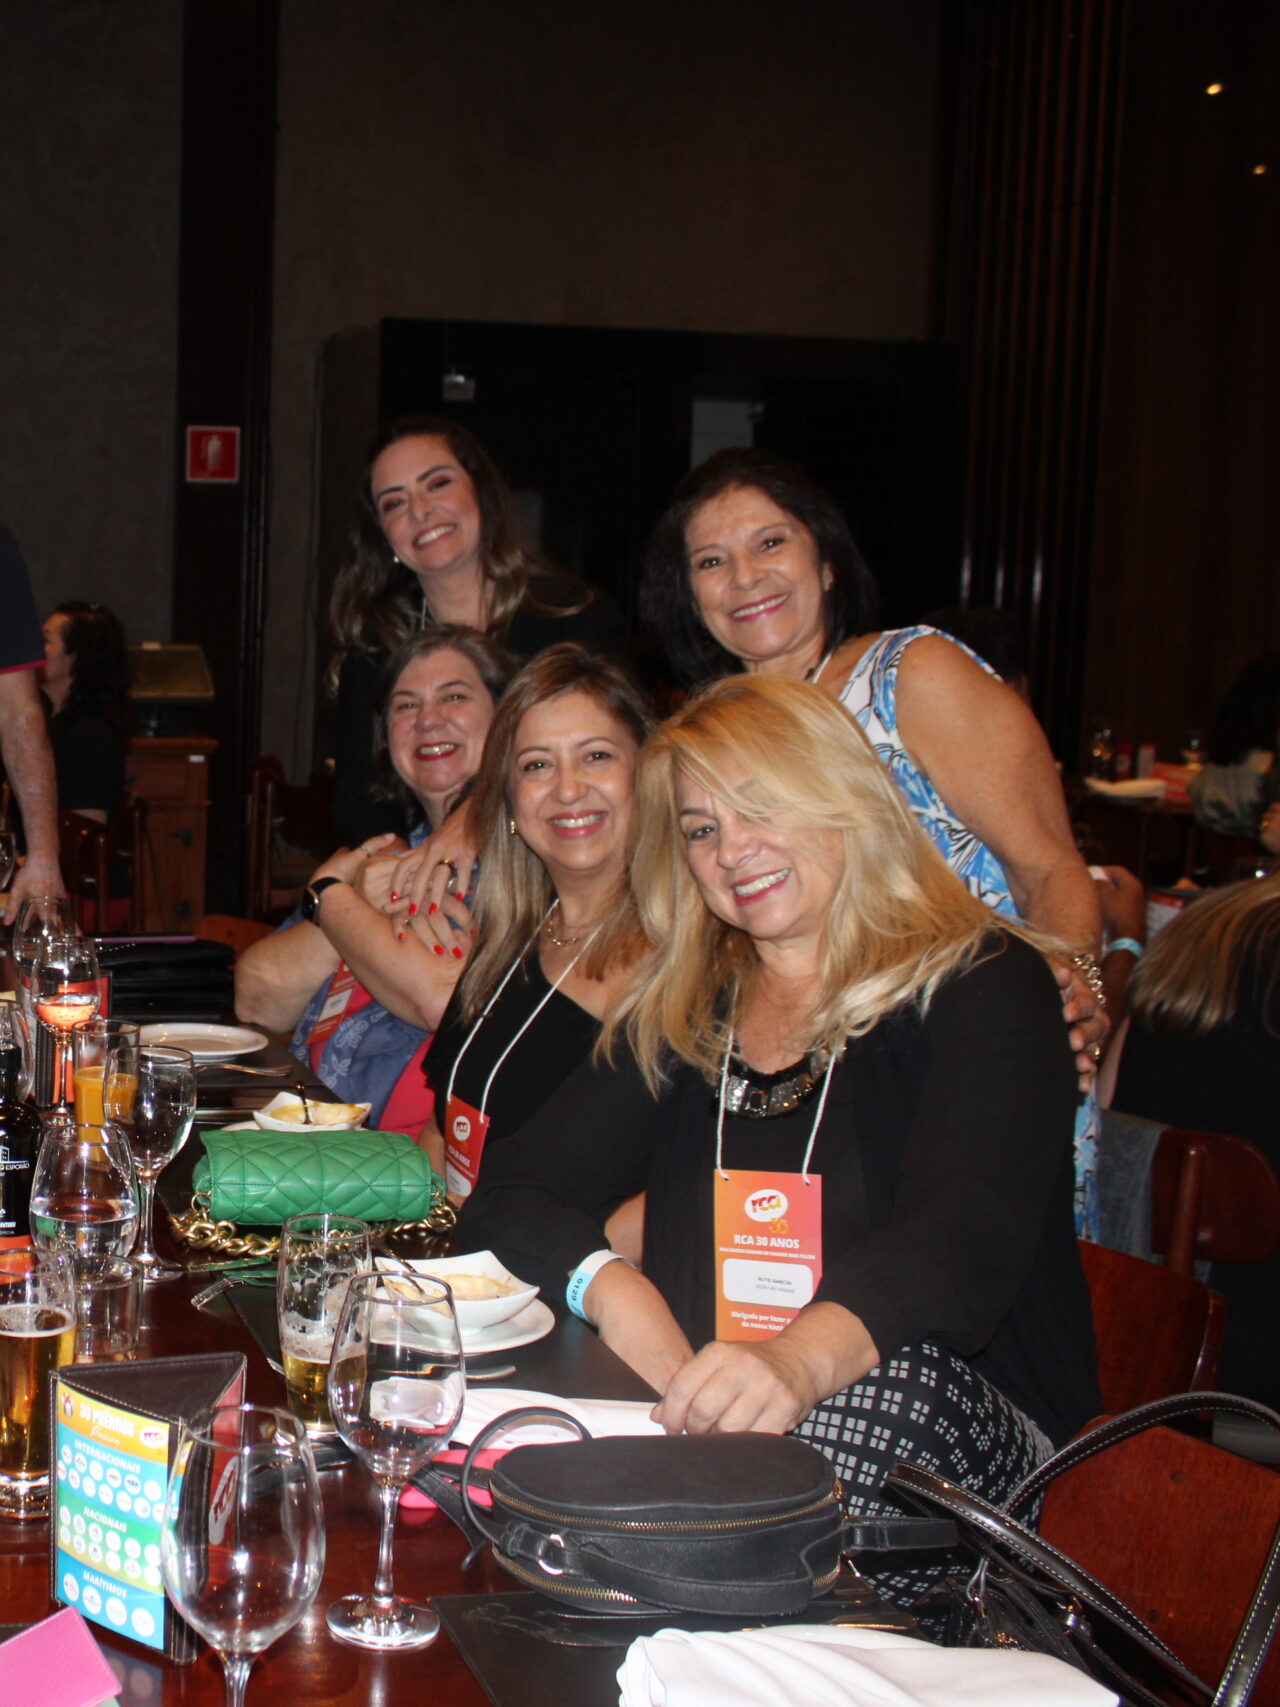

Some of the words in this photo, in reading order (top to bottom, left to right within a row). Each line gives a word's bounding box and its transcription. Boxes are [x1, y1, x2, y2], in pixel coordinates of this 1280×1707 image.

[734, 1234, 754, 1245] RCA
[755, 1236, 768, 1246] 30
[769, 1237, 800, 1249] ANOS
[571, 1278, 584, 1301] 0129
[80, 1403, 91, 1420] 30
[93, 1408, 135, 1438] PRÊMIOS
[74, 1439, 141, 1474] INTERNACIONAIS
[83, 1506, 128, 1533] NACIONAIS
[82, 1570, 128, 1599] MARÍTIMOS
